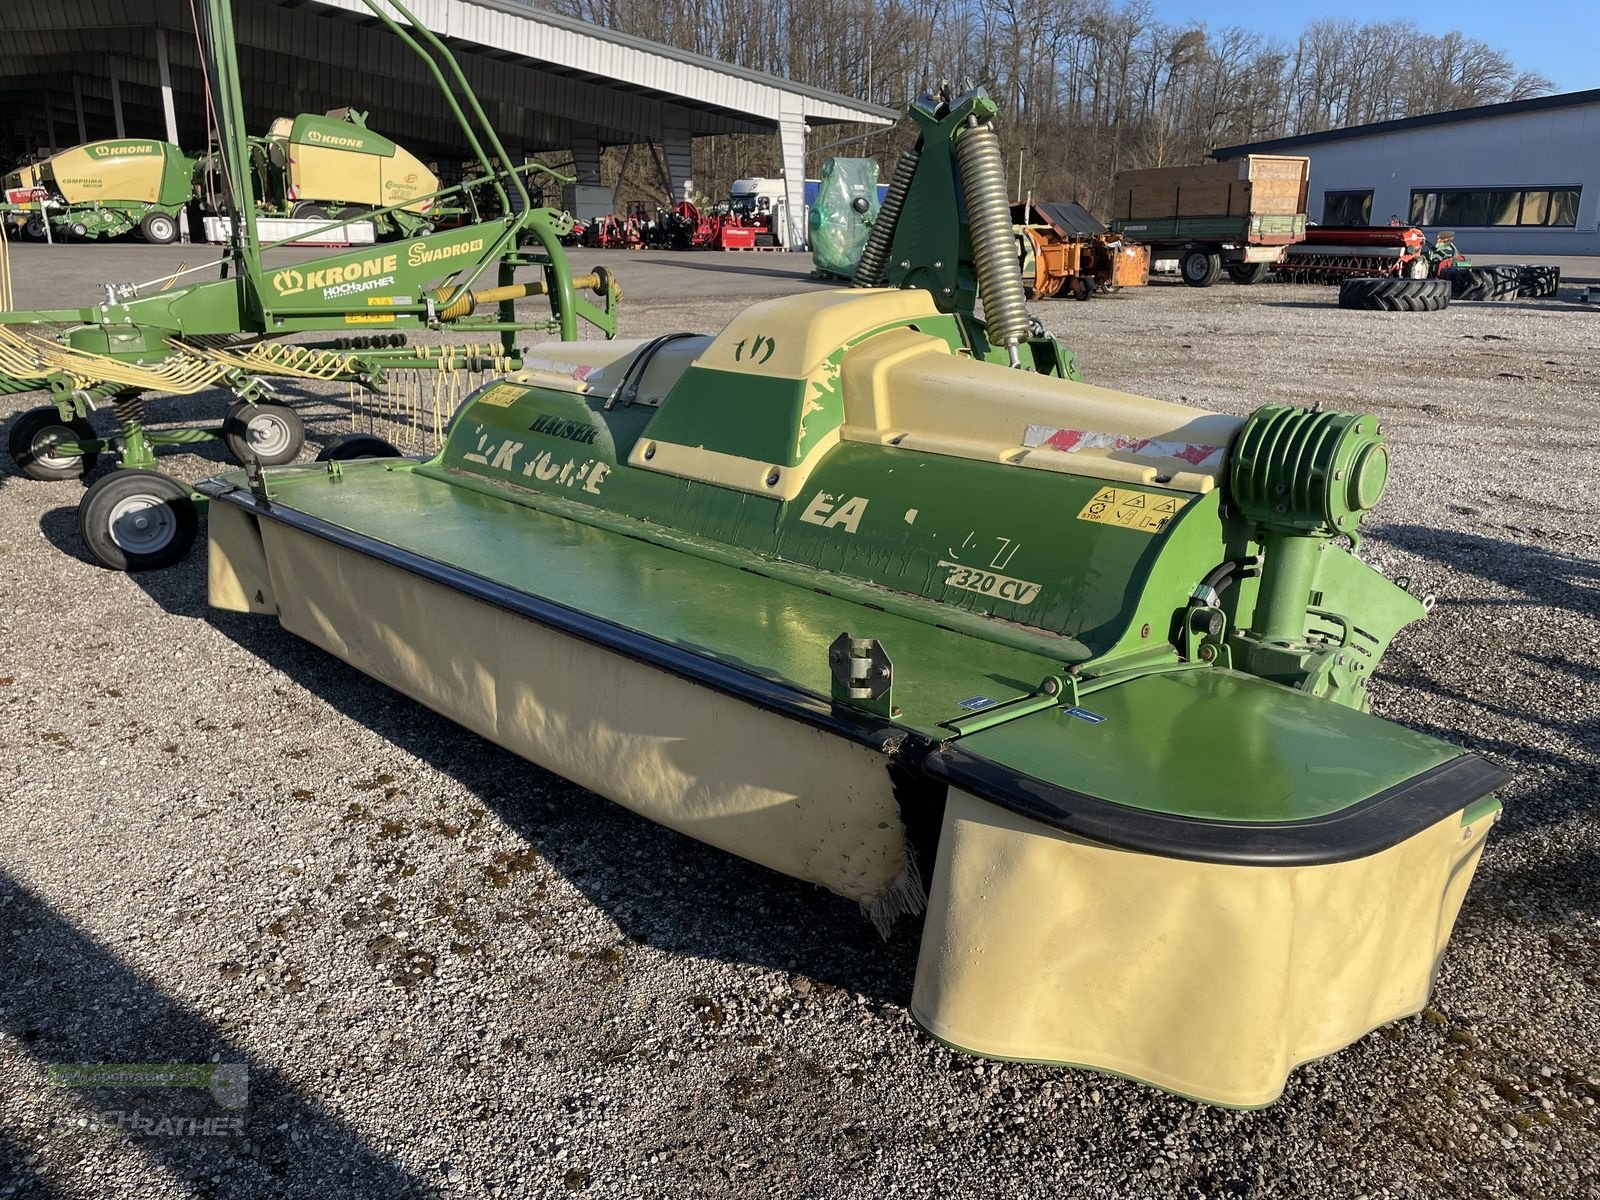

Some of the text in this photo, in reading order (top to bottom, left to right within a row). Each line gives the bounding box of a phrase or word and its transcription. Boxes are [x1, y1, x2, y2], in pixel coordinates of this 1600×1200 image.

[110, 145, 153, 155] KRONE
[322, 135, 364, 148] KRONE
[306, 254, 397, 290] KRONE
[323, 276, 395, 298] HOCHRATHER
[528, 414, 600, 445] HAUSER
[1081, 512, 1101, 521] STOP
[998, 580, 1033, 601] CV
